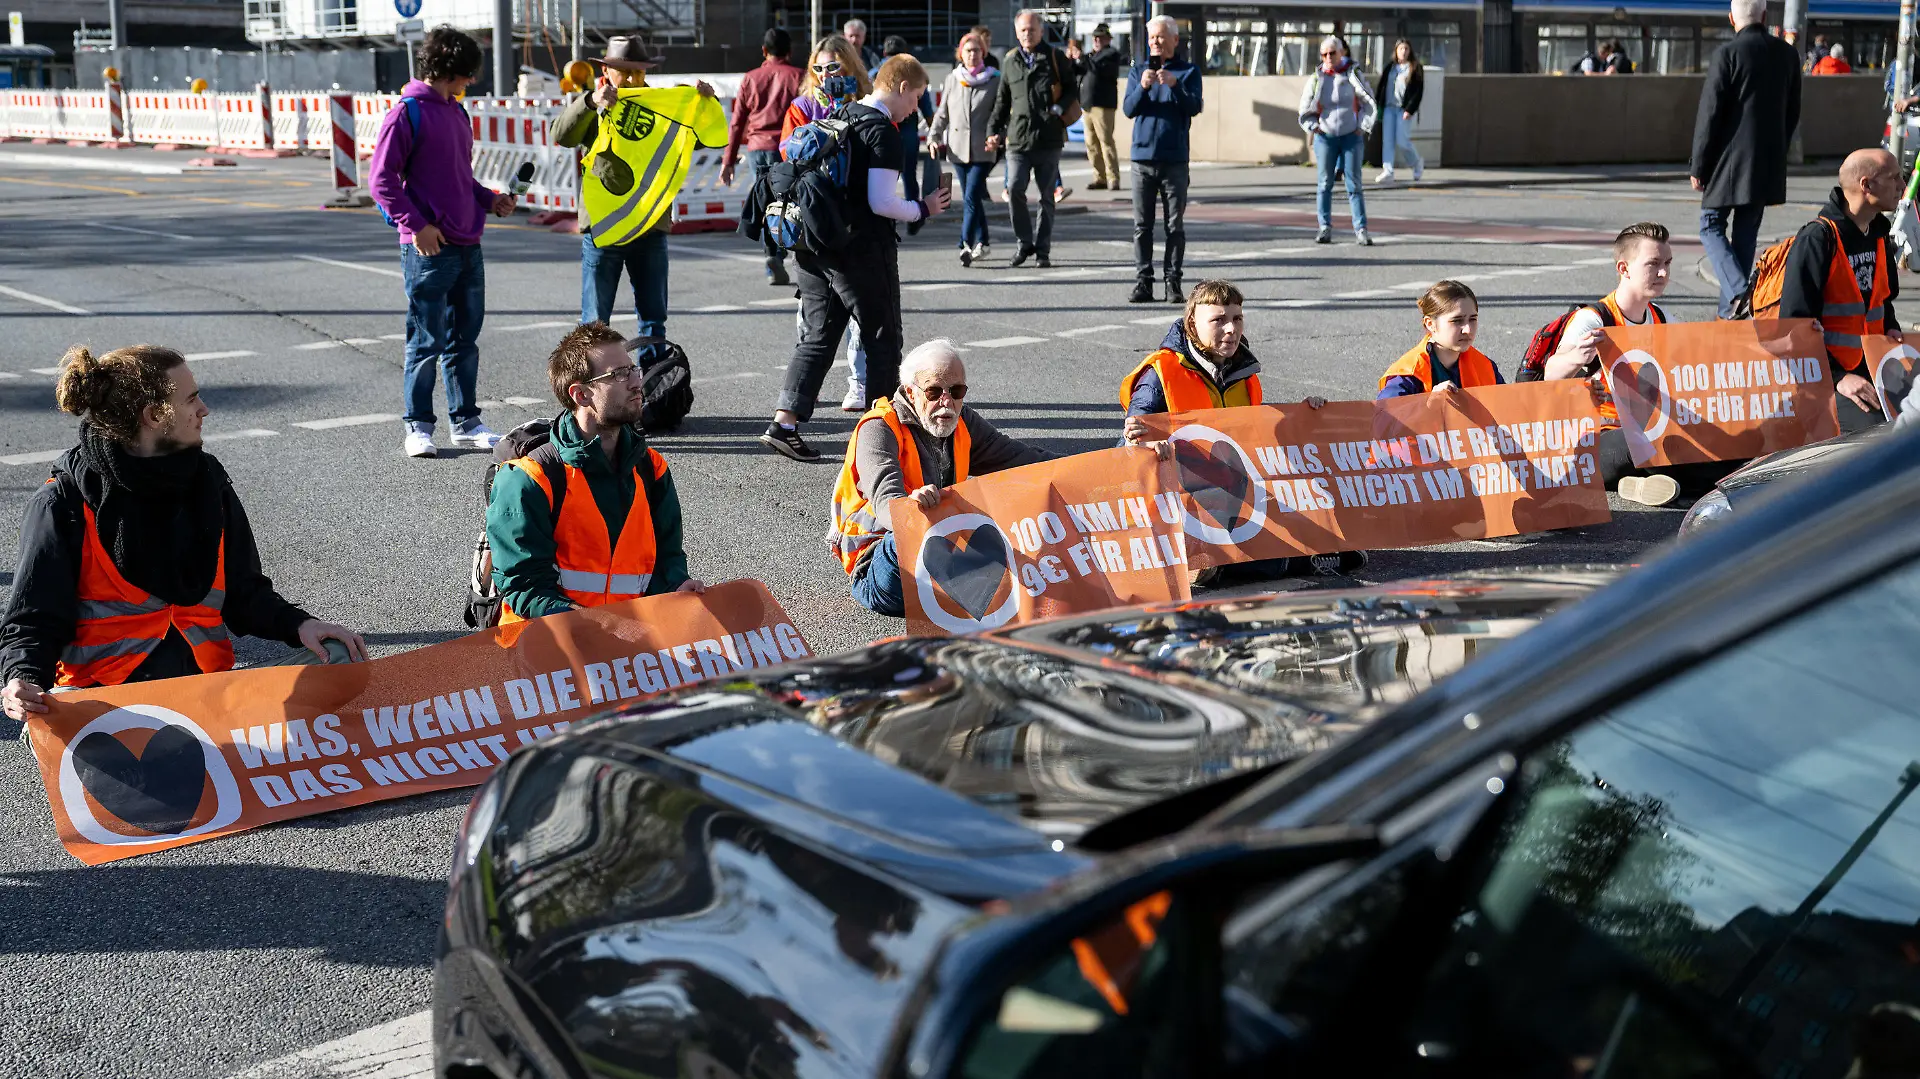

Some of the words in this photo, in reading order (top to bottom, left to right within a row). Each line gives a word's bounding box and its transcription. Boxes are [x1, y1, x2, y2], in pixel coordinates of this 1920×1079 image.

[1670, 363, 1709, 392] 100
[1713, 360, 1771, 389] KM/H
[1772, 357, 1823, 385] UND
[1676, 397, 1702, 426] 9€
[1706, 391, 1745, 423] FÜR
[1750, 391, 1795, 420] ALLE
[1255, 443, 1332, 475] WAS,
[1329, 436, 1413, 471] WENN
[1416, 429, 1467, 464] DIE
[1467, 417, 1595, 458] REGIERUNG
[1272, 477, 1335, 513] DAS
[1335, 473, 1421, 507] NICHT
[1422, 467, 1465, 500] IM
[1469, 459, 1529, 497] GRIFF
[1533, 453, 1596, 489] HAT?
[1010, 511, 1067, 554] 100
[1065, 496, 1153, 533] KM/H
[1153, 491, 1181, 525] U
[1021, 555, 1070, 597] 9€
[1067, 535, 1127, 577] FÜR
[230, 713, 360, 769] WAS,
[362, 685, 502, 748] WENN
[504, 668, 581, 720] DIE
[583, 622, 809, 705] REGIERUNG
[250, 763, 363, 808] DAS
[361, 734, 511, 786] NICHT
